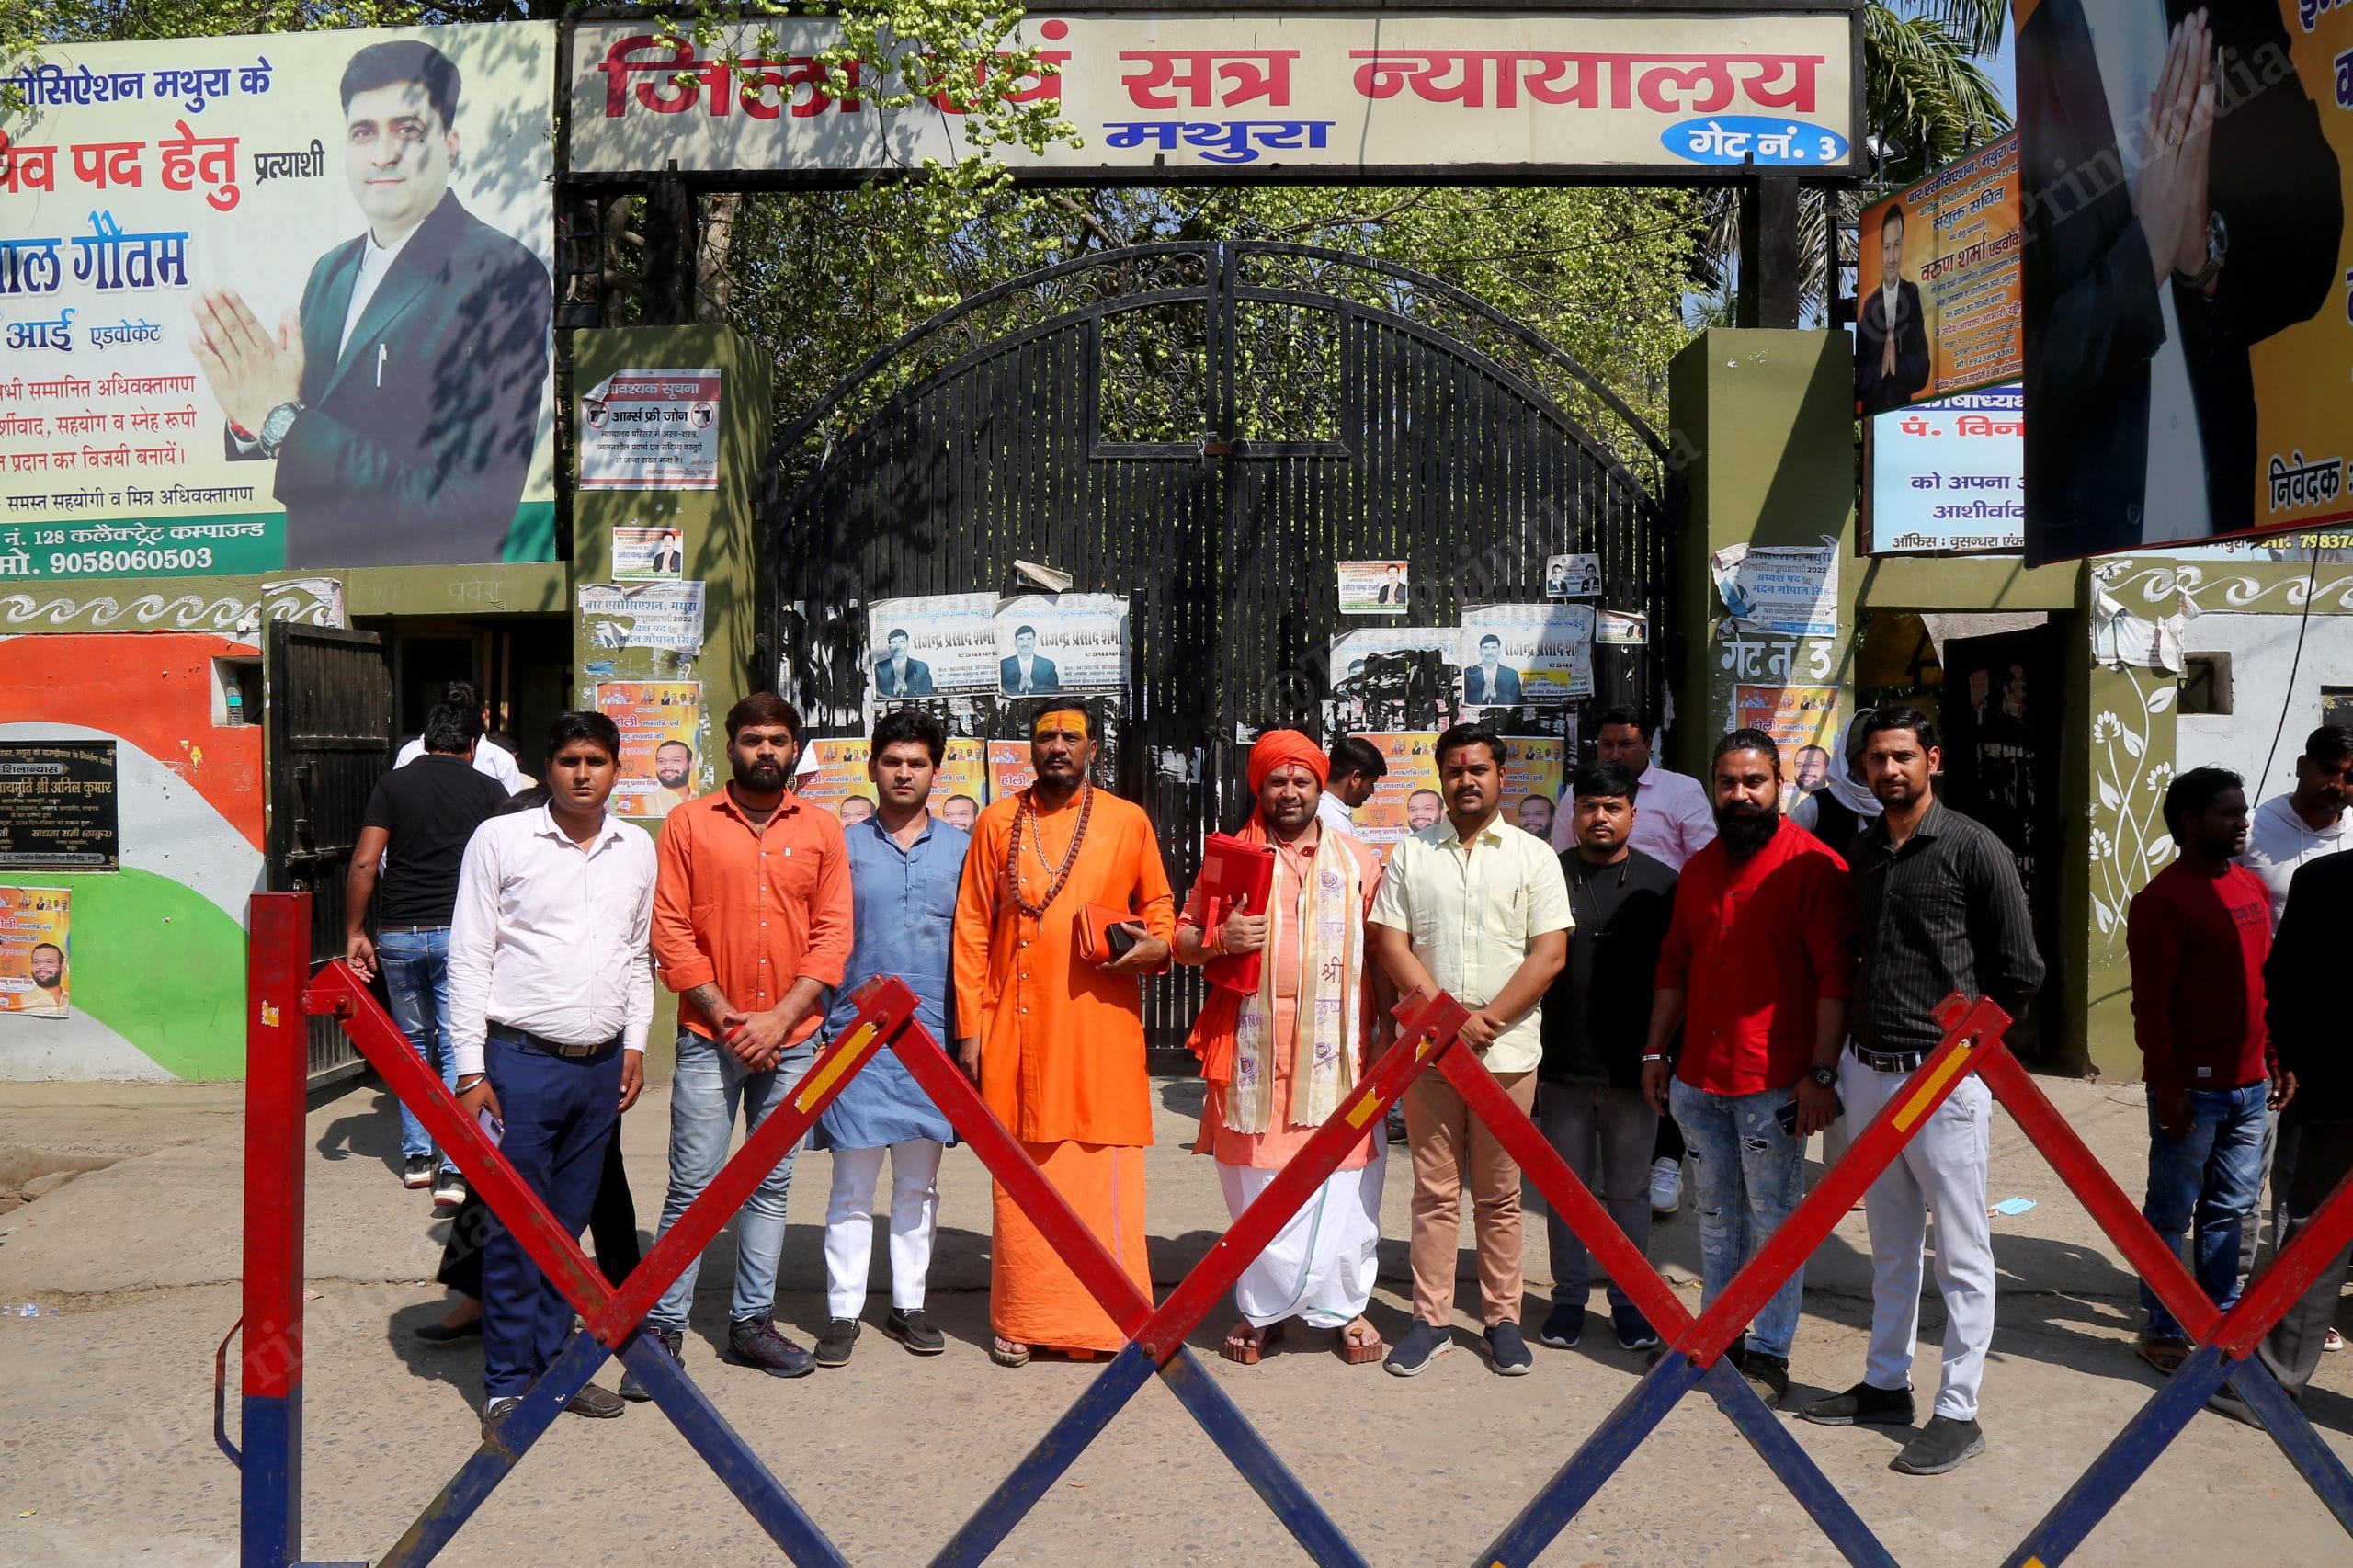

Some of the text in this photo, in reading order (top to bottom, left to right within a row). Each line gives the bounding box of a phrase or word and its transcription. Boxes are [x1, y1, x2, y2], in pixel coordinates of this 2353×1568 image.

[153, 56, 273, 113] मथुरा के
[598, 35, 867, 119] जिला
[1120, 50, 1301, 109] सत्र
[1349, 50, 1824, 113] न्यायालय
[1103, 121, 1336, 163] मथुरा
[1688, 120, 1837, 160] गेट नं. 3
[70, 119, 325, 212] पद हेतु प्रत्याशी
[1981, 144, 2007, 167] मथुरा
[1933, 187, 2004, 230] संयुक्त सचिव
[0, 210, 189, 294] ाल गौतम
[1920, 232, 1986, 281] वरुण शर्मा
[6, 308, 162, 352] आई एडवोकेट
[28, 374, 91, 402] सम्मानित
[97, 372, 196, 398] अधिवक्तागण
[662, 383, 700, 400] सूचना
[55, 403, 197, 438] सहयोग व स्नेह रूपी
[612, 407, 688, 422] आर्म्स फ्री जोन
[1900, 416, 1941, 437] पं.
[10, 453, 48, 474] प्रदान
[52, 452, 77, 470] कर
[82, 443, 131, 467] विजयी
[1911, 472, 2011, 490] को अपना
[2269, 452, 2341, 509] निवेदक
[6, 483, 254, 512] समस्त सहयोगी व मित्र अधिवक्तागण
[5, 528, 27, 546] नं.
[34, 530, 65, 545] 128
[169, 522, 266, 539] कम्पाउन्ड
[1893, 533, 1937, 549] ऑफिस
[0, 547, 212, 575] मो. 9058060503
[1753, 585, 1775, 594] मदन
[1778, 583, 1808, 595] गोपाल
[585, 597, 698, 615] बार एसोसिएशन, मथुरा
[643, 633, 675, 643] गोपाल
[1722, 636, 1766, 680] गेट
[1809, 641, 1833, 679] 3
[2, 764, 58, 774] शिलान्यास
[37, 777, 112, 798] श्री अनिल कुमार
[32, 829, 60, 838] साधना
[62, 827, 80, 838] रानी
